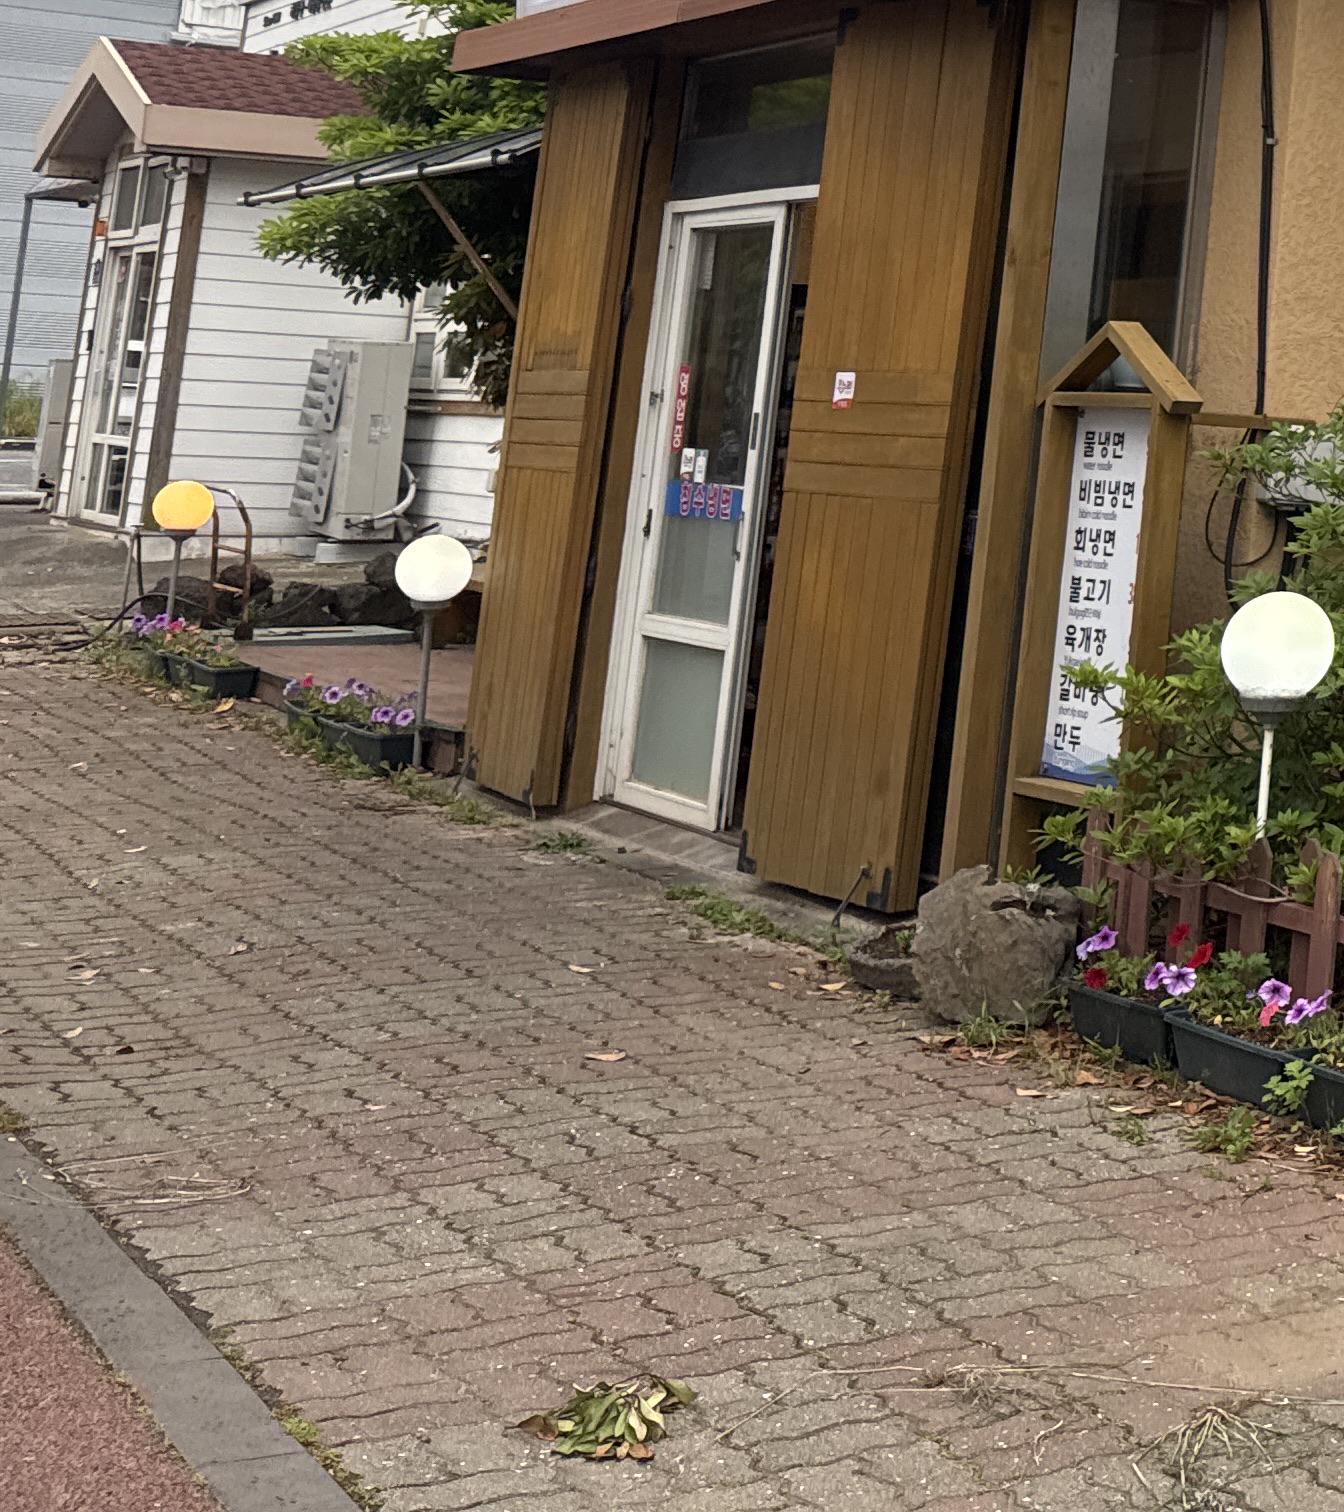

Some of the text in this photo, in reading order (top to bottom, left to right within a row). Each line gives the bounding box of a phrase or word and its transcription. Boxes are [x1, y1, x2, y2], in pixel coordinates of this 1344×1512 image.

[1083, 431, 1125, 459] 물냉면
[1079, 478, 1135, 509] 비빔냉면
[1073, 527, 1116, 557] 회냉면
[1069, 575, 1112, 605] 불고기
[1064, 624, 1107, 657] 육개장
[1053, 722, 1081, 752] 만두
